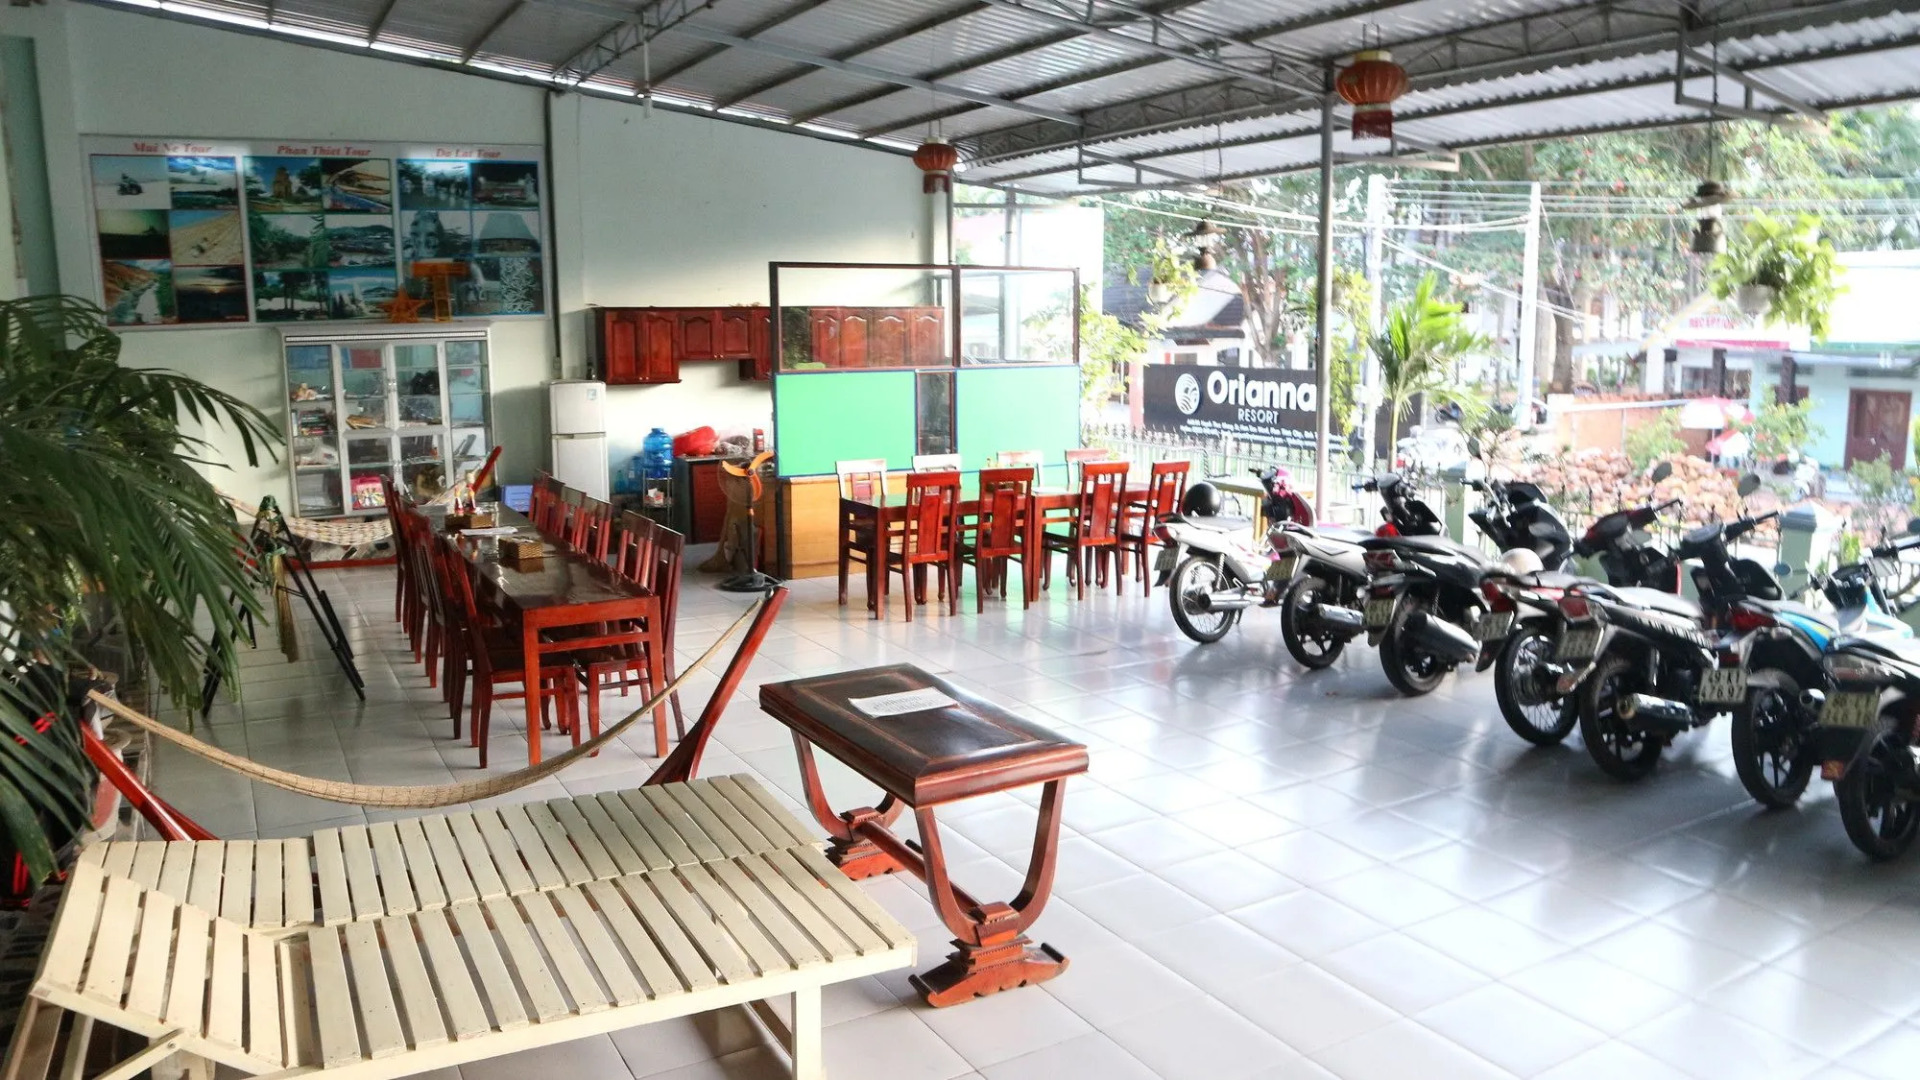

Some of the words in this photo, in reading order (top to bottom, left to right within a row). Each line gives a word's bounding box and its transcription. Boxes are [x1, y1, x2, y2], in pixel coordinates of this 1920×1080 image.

[184, 142, 212, 153] Tour
[277, 145, 307, 155] Phan
[344, 146, 371, 156] Tour
[477, 148, 501, 158] Tour
[1207, 370, 1317, 412] Orianna
[1237, 408, 1279, 424] RESORT
